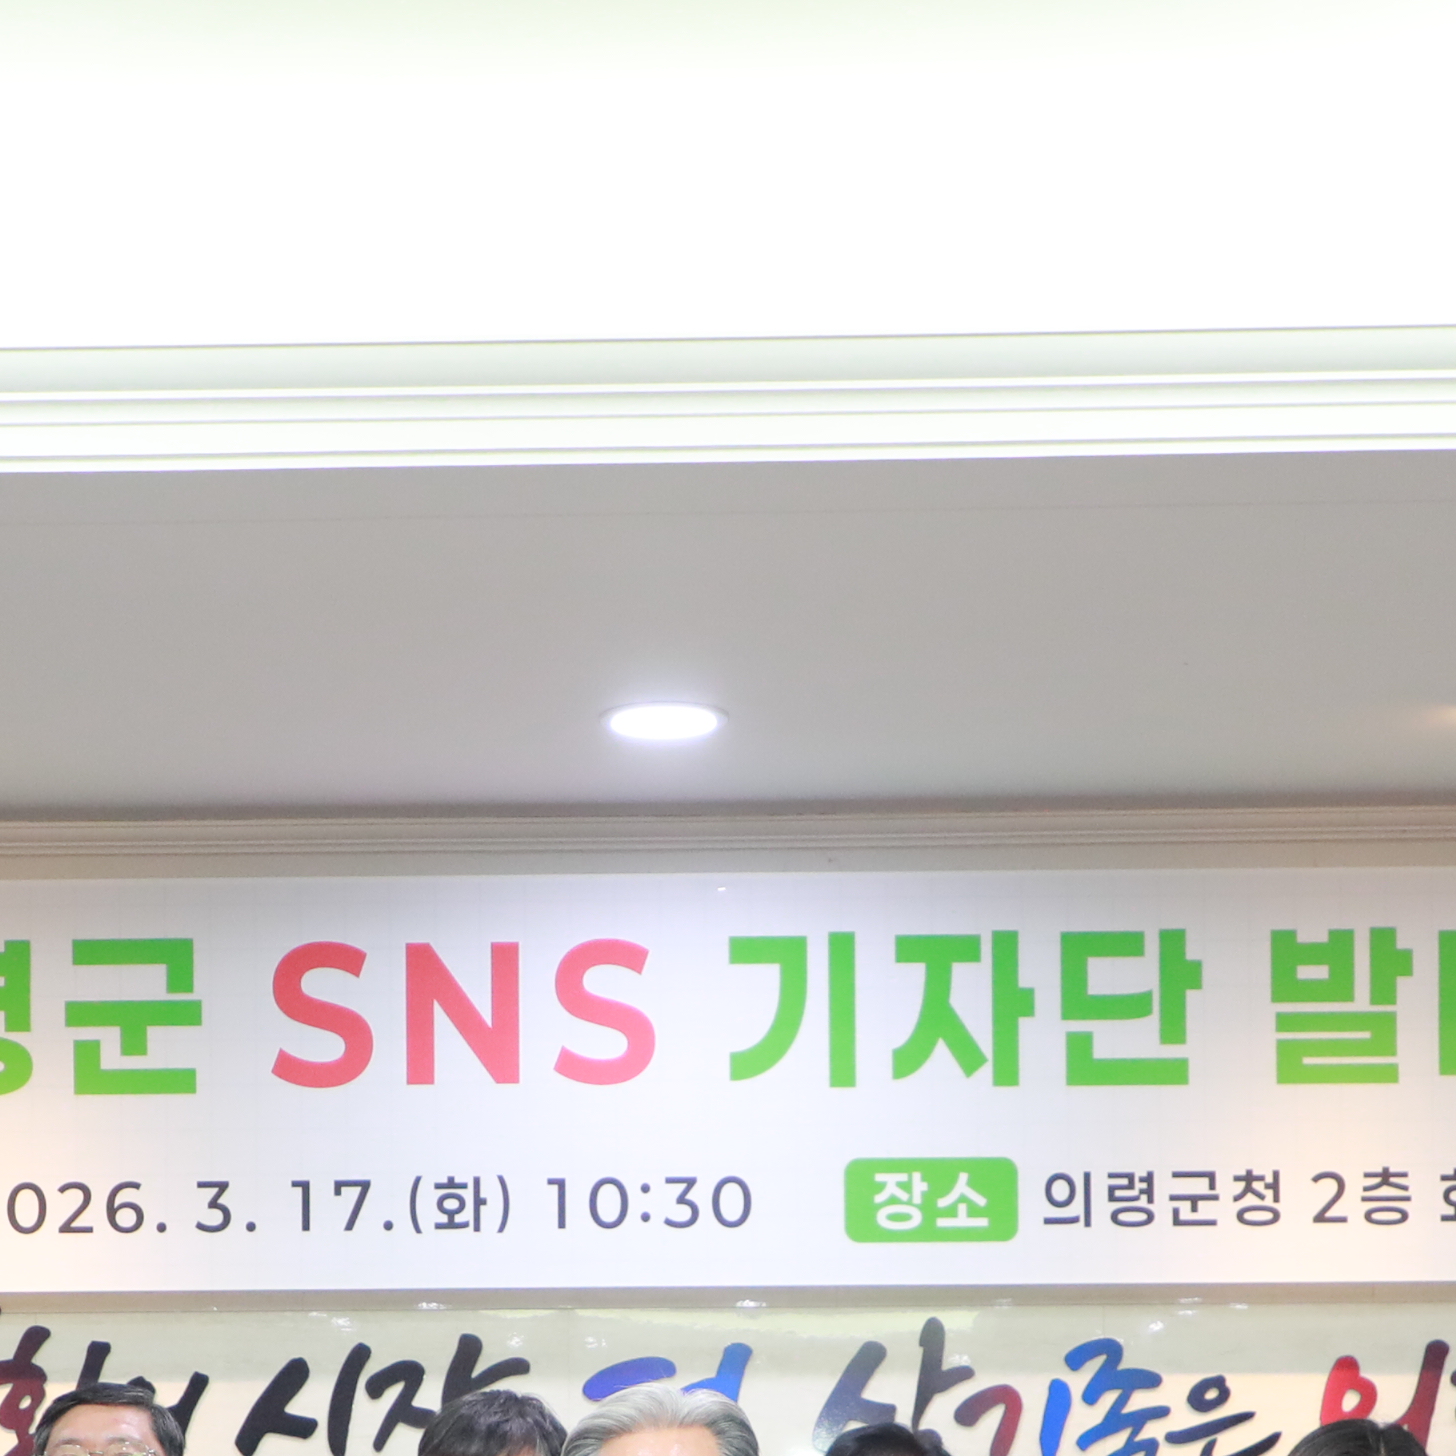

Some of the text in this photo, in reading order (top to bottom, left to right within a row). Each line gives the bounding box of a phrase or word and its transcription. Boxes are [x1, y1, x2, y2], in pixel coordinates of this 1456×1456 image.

[273, 939, 656, 1089] SNS
[728, 928, 1201, 1088] 기자단
[196, 1181, 256, 1233] 3.
[548, 1179, 752, 1229] 10:30
[871, 1173, 990, 1230] 장소
[1043, 1170, 1281, 1229] 의령군청
[1313, 1167, 1411, 1225] 2층
